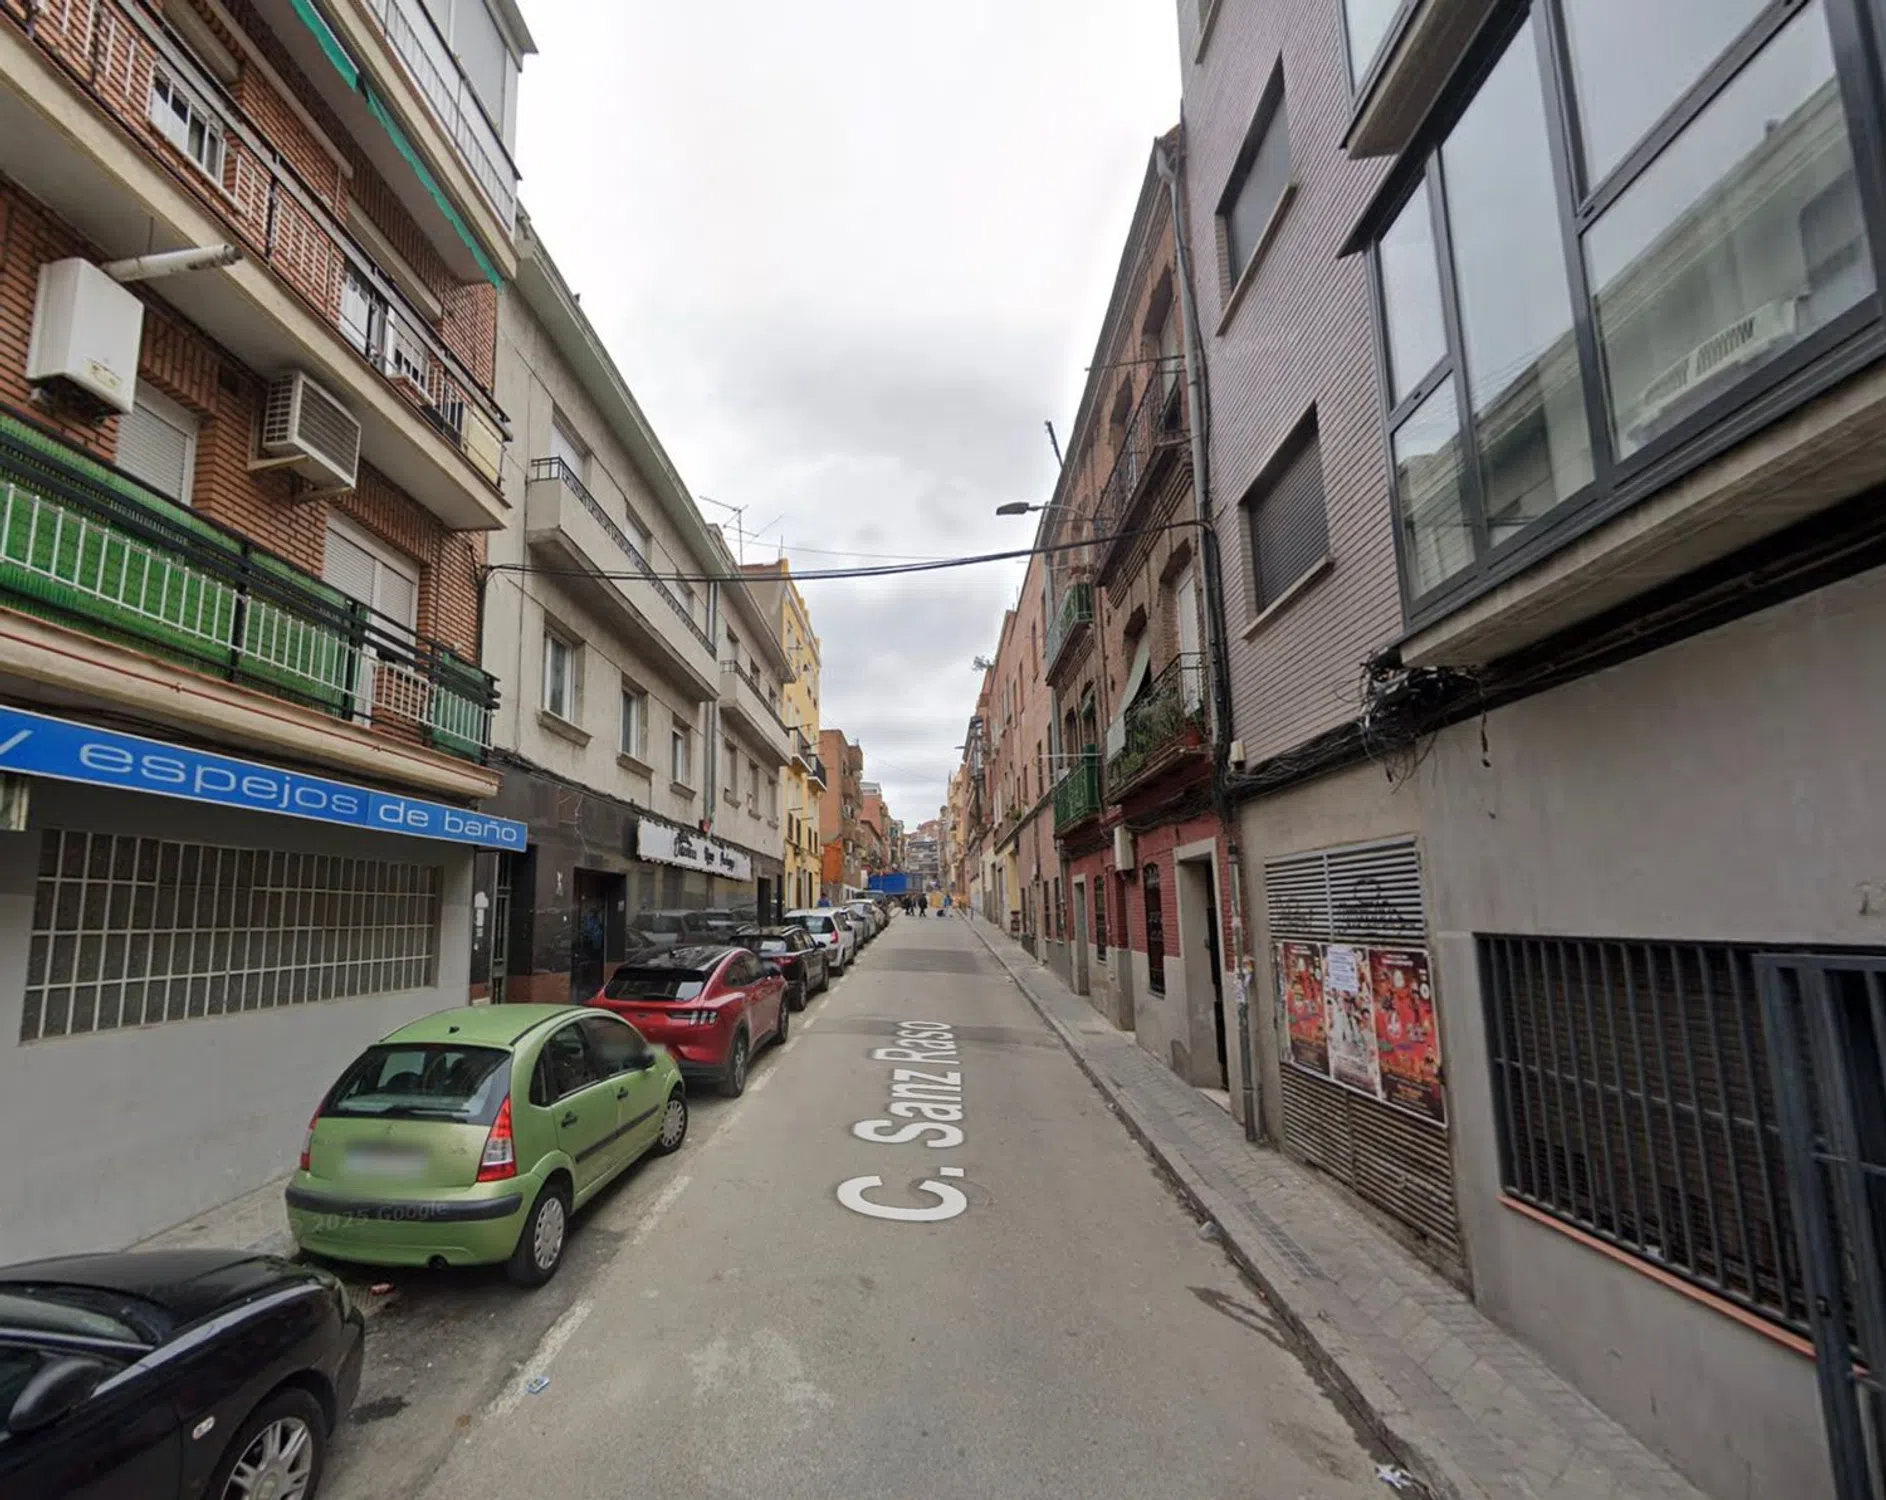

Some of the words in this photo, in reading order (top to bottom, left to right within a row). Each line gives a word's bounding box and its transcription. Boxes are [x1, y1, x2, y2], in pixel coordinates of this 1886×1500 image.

[79, 742, 359, 814] espejos
[379, 801, 429, 827] de
[444, 810, 518, 843] baño
